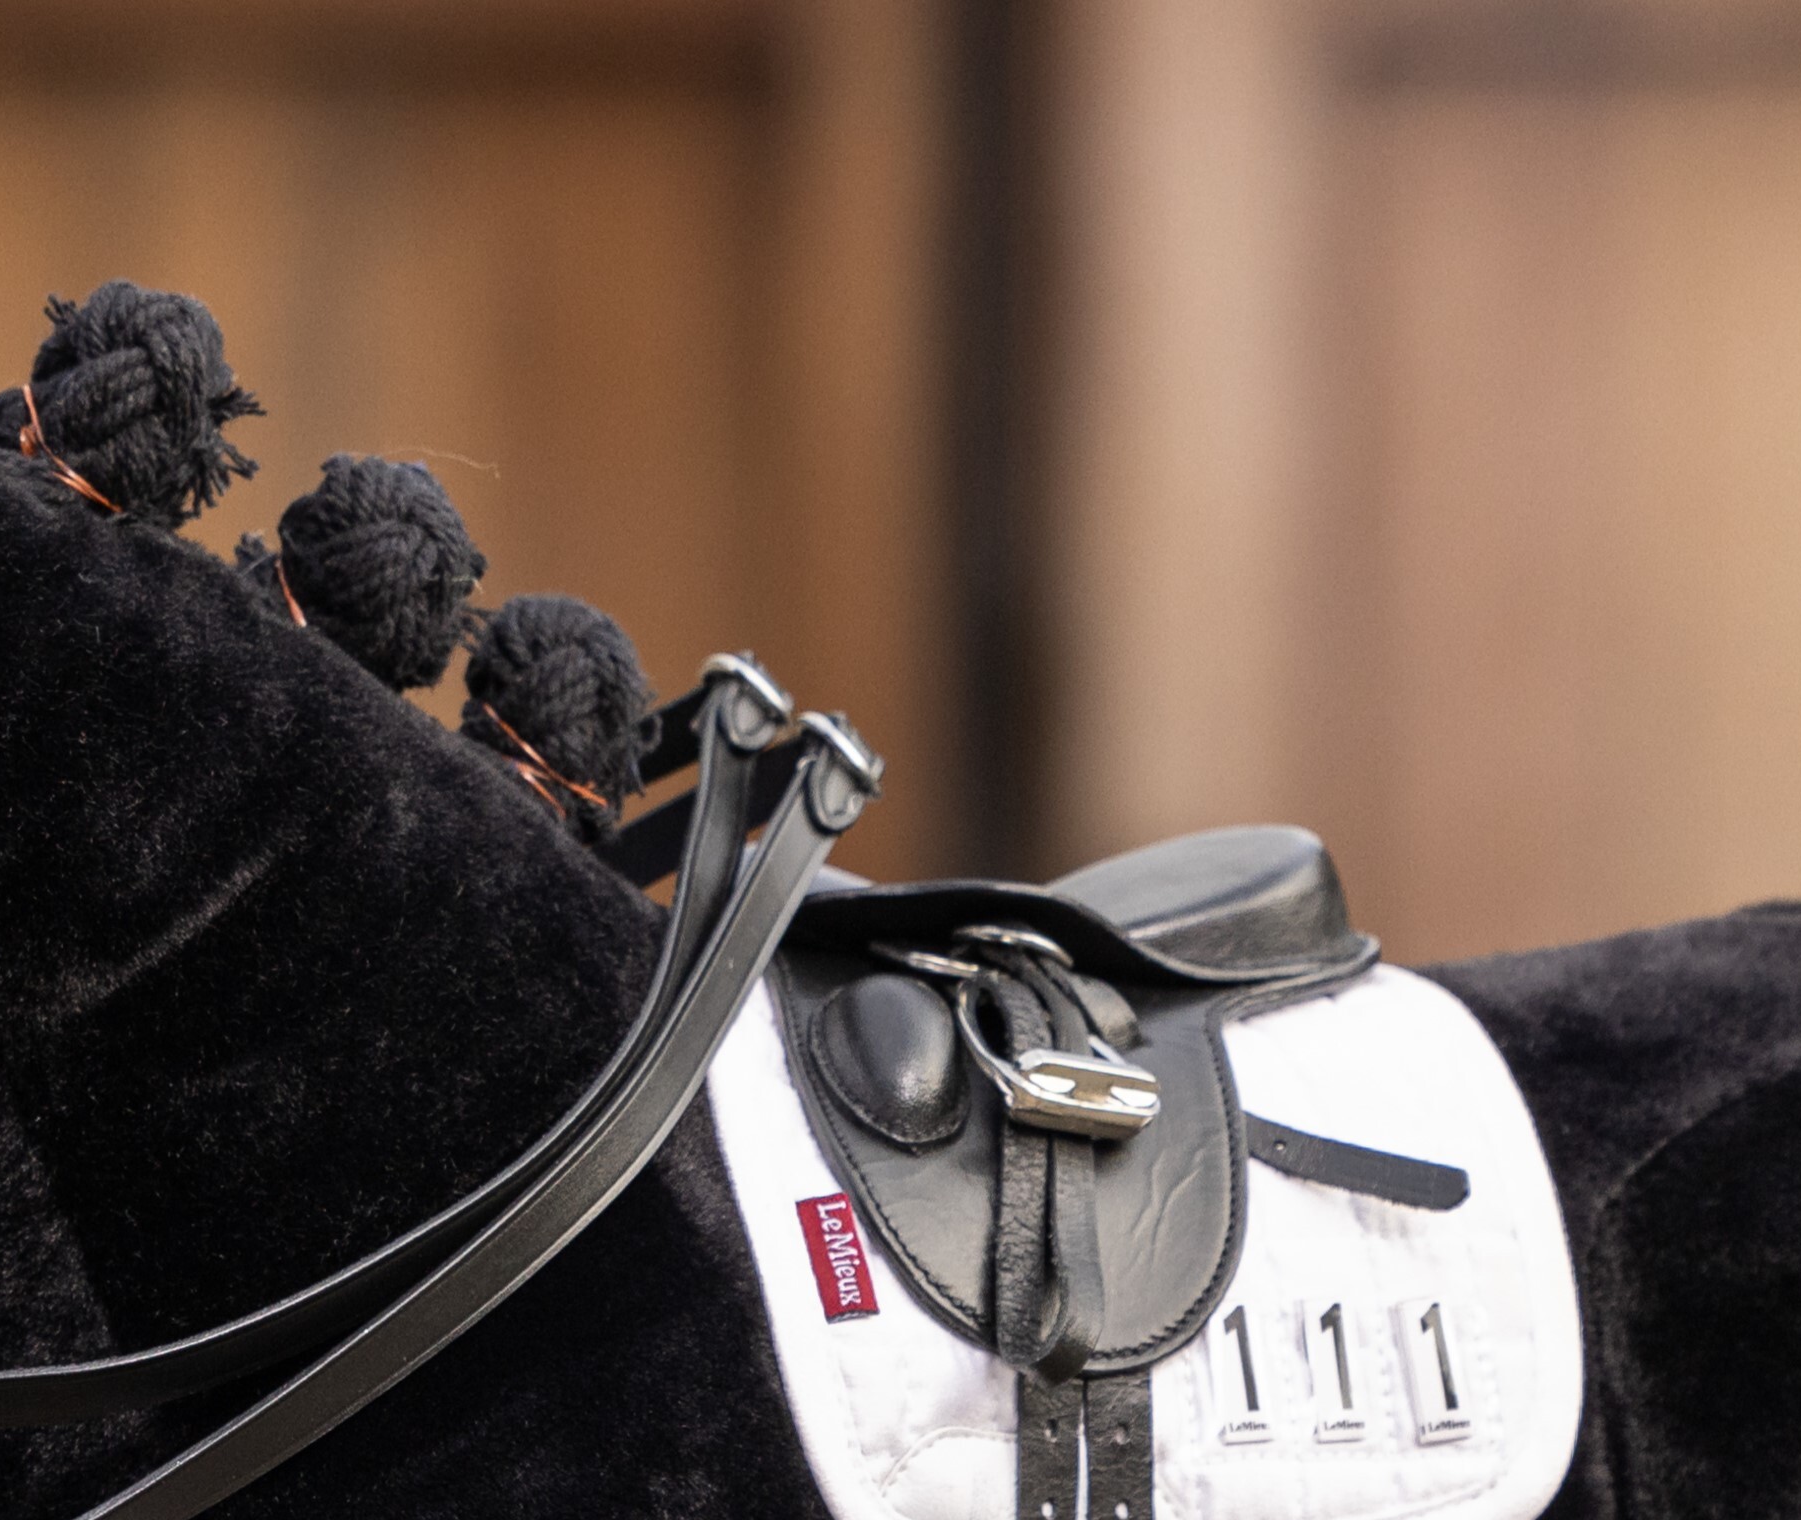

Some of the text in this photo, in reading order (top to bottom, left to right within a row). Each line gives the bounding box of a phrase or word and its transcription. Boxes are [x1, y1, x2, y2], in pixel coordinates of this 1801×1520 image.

[816, 1200, 862, 1307] LeMieux
[1223, 1302, 1459, 1412] 1 1 1
